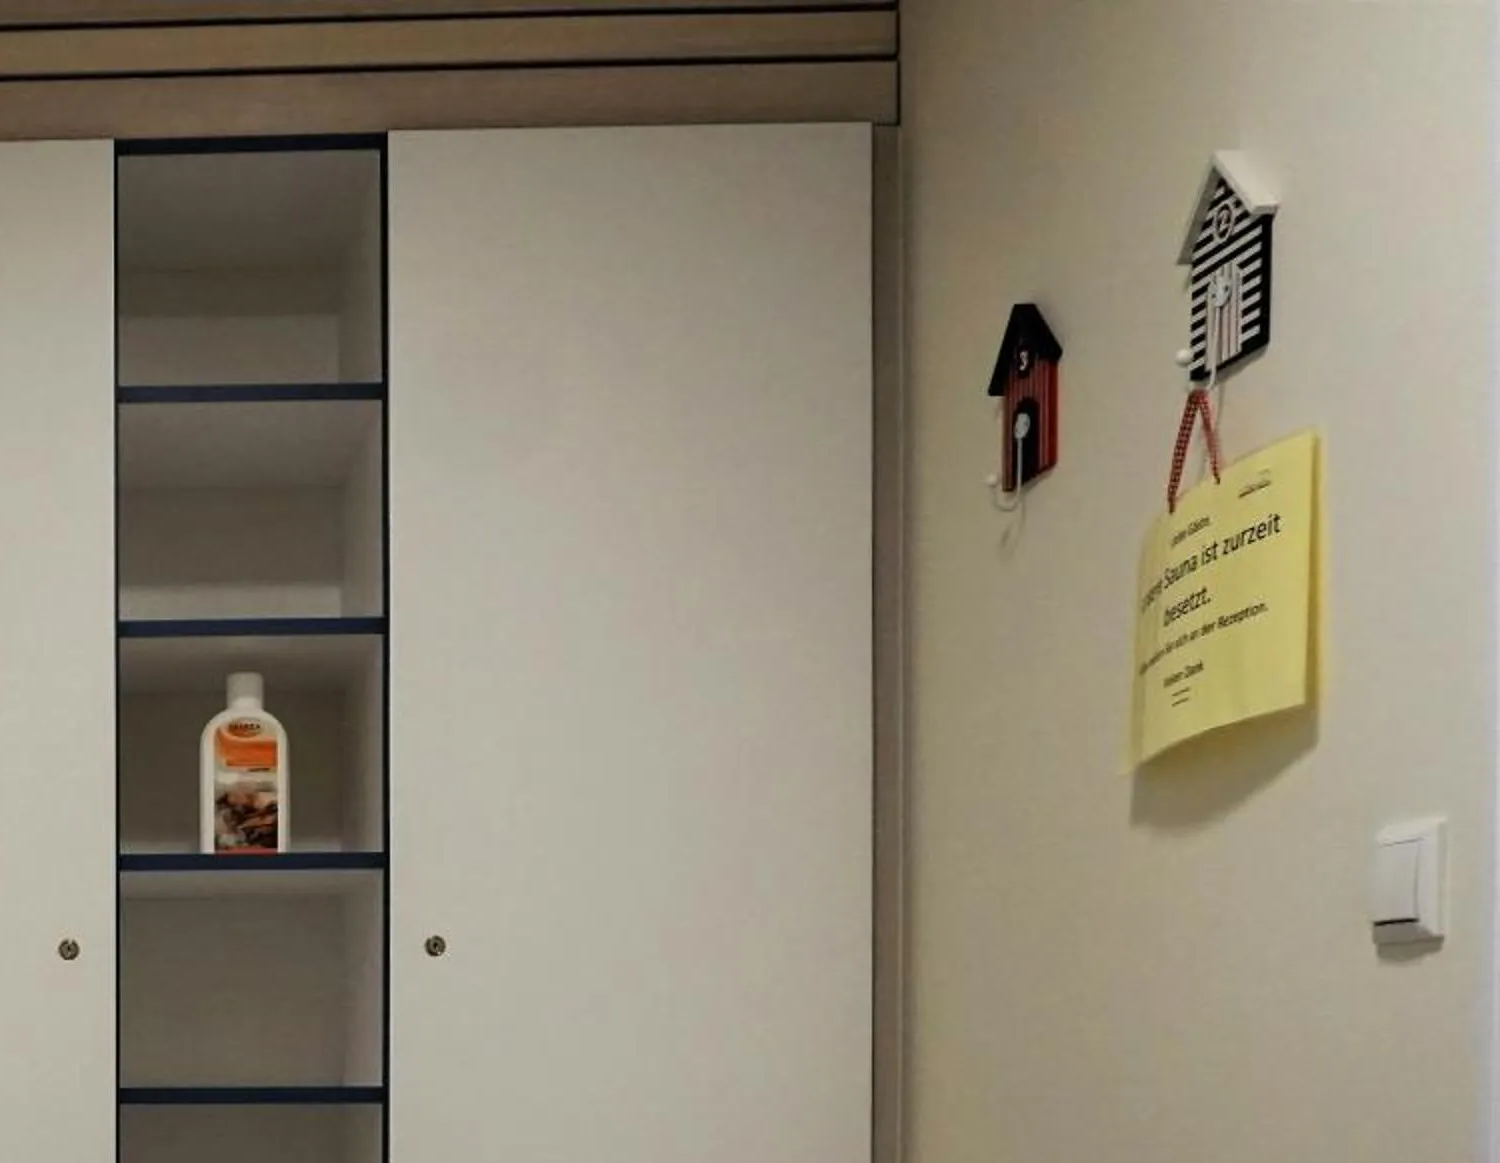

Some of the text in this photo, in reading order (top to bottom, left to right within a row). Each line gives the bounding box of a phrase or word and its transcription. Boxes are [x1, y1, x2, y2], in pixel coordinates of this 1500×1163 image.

[1163, 554, 1198, 589] Sauna
[1201, 540, 1219, 566] ist
[1221, 513, 1281, 556] zurzeit
